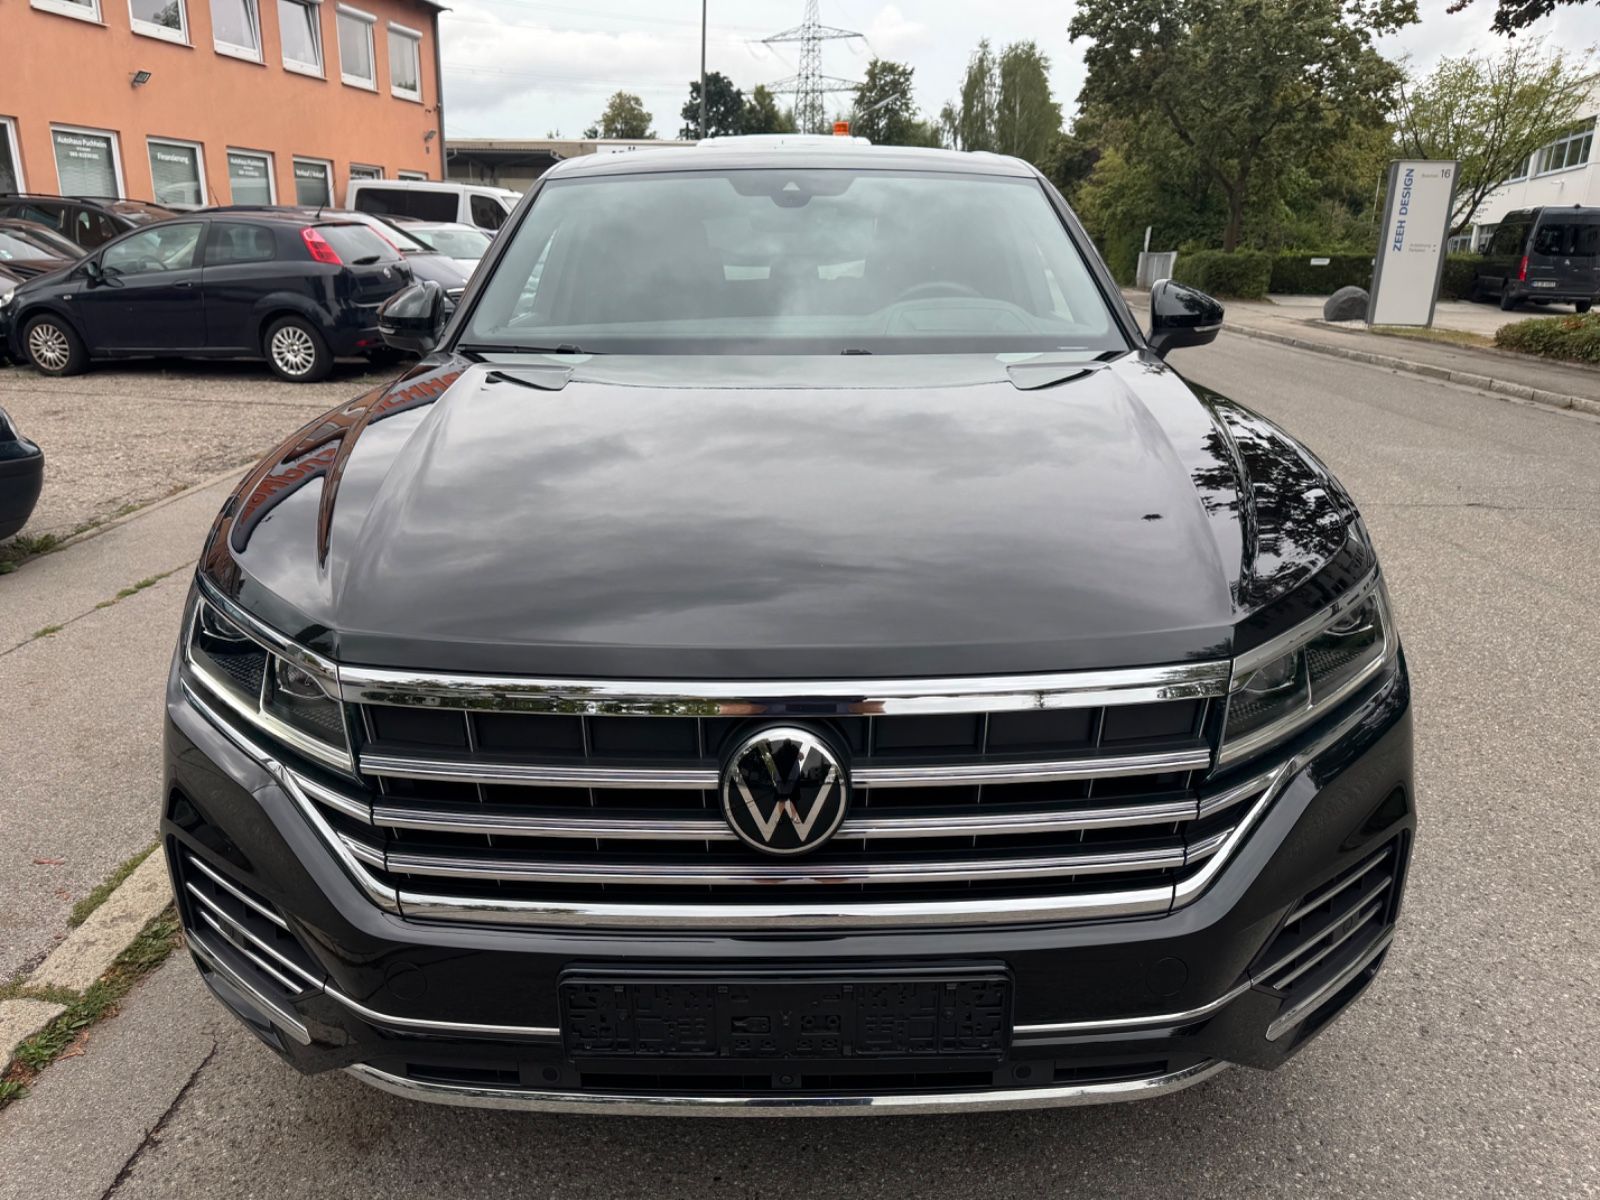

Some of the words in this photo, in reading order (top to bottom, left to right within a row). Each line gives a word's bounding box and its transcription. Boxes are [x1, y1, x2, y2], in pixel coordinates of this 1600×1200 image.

[1399, 168, 1415, 216] DESIGN
[1441, 169, 1451, 179] 16
[1393, 220, 1406, 252] ZEEH
[731, 735, 839, 842] VW
